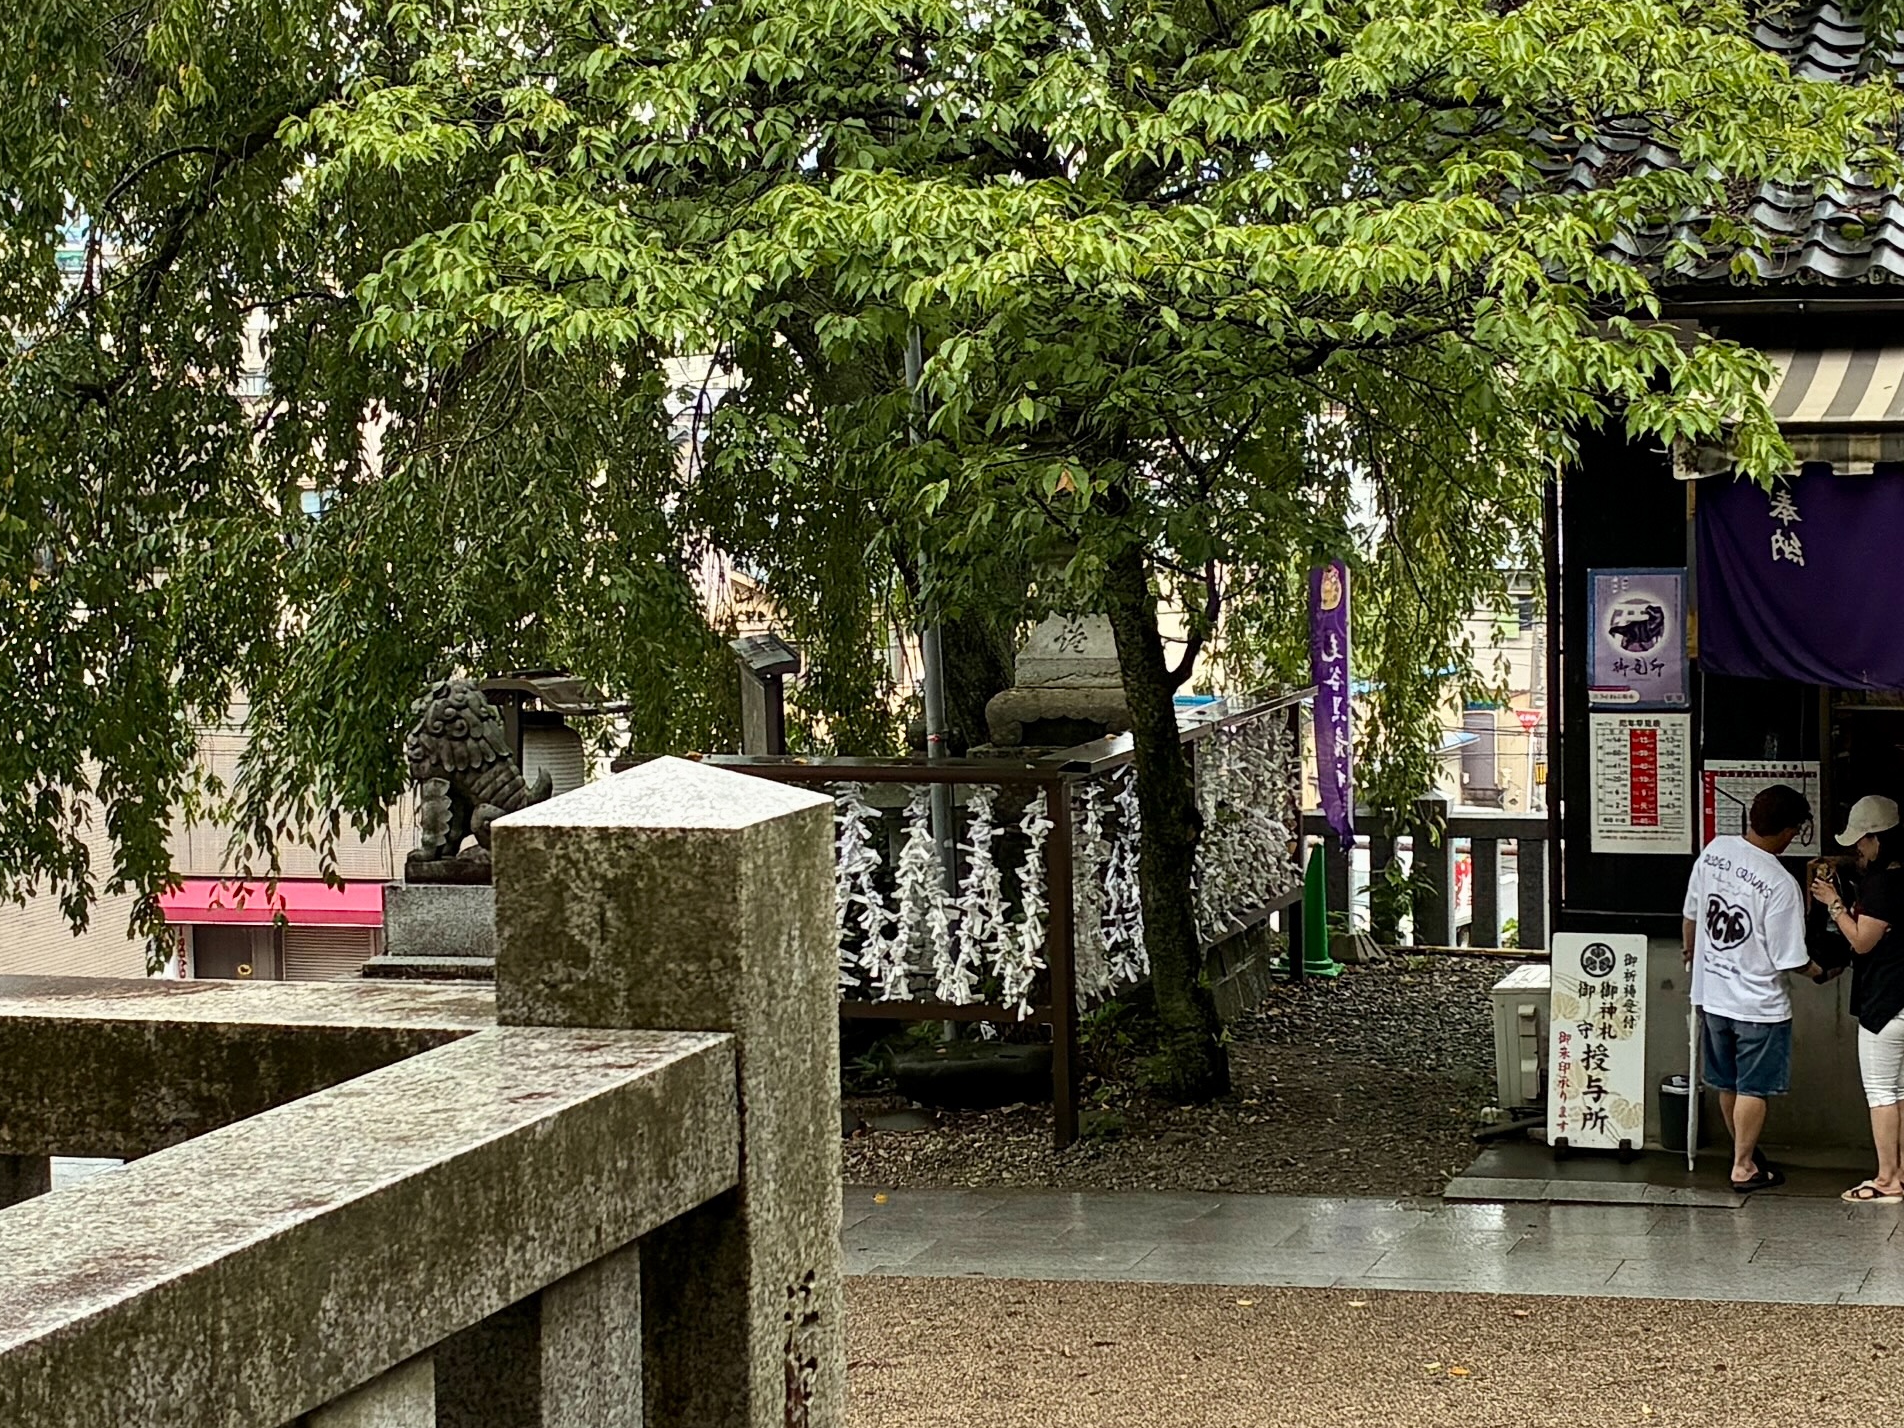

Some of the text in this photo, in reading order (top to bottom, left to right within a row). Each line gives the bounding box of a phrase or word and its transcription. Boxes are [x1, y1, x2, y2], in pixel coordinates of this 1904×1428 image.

[1600, 981, 1618, 1040] 御神札
[1580, 1043, 1611, 1135] 授与所
